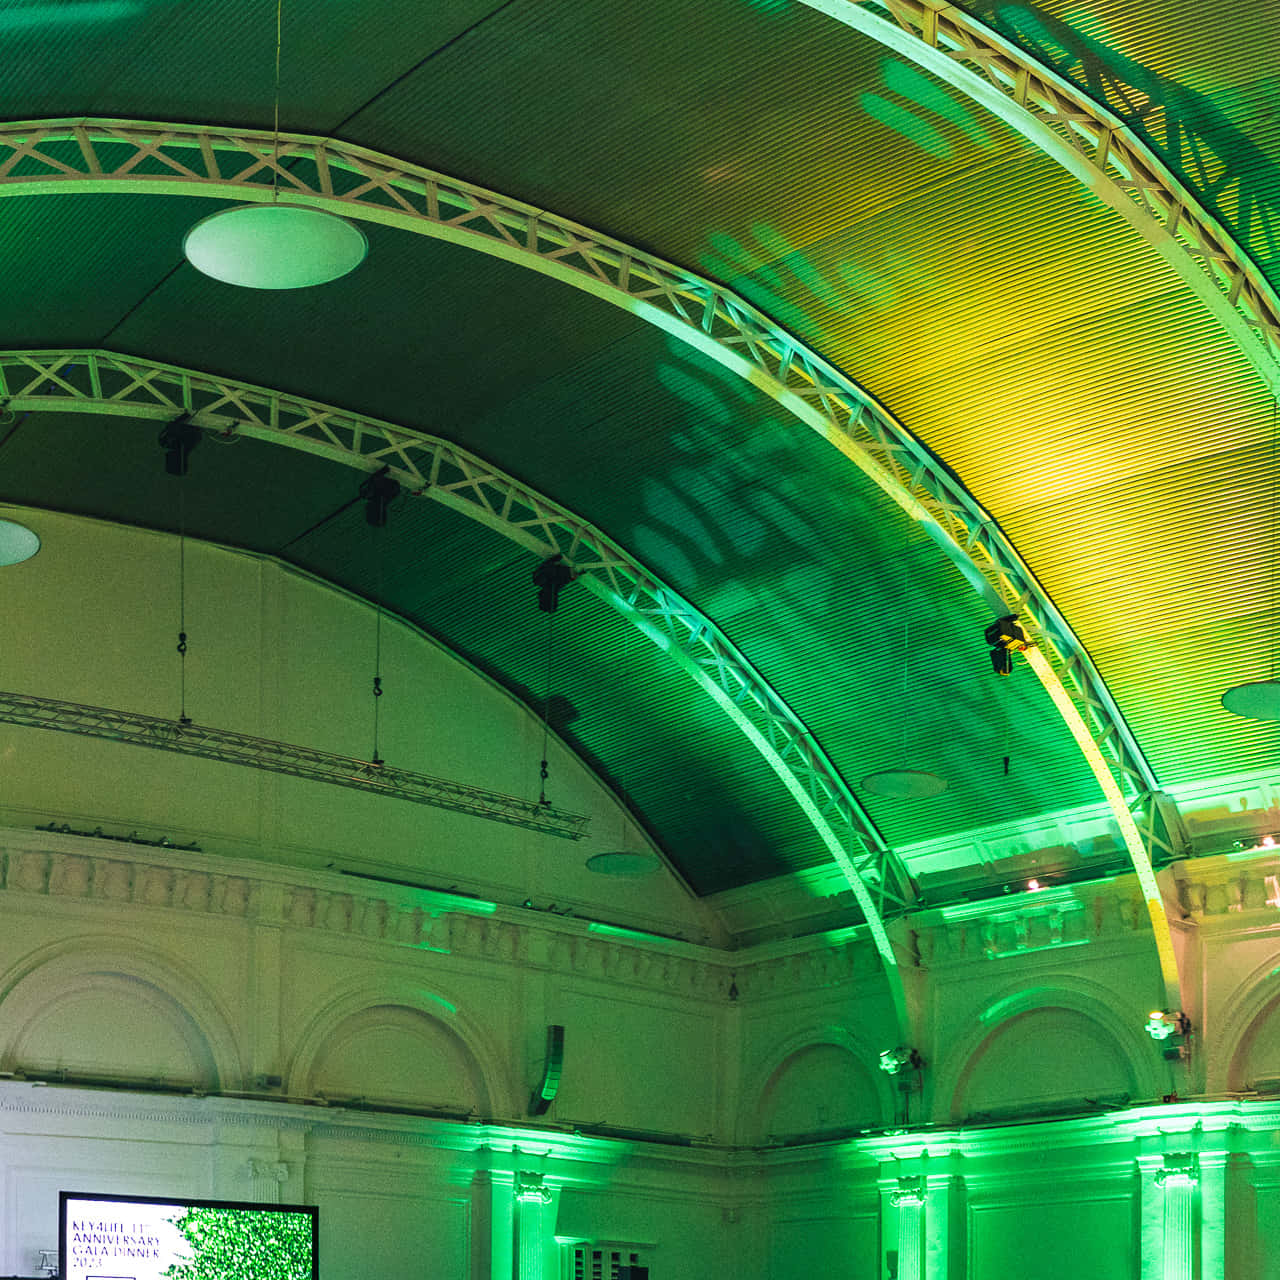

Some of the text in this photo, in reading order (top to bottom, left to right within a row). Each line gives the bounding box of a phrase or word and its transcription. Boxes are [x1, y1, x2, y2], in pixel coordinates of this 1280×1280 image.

[72, 1232, 160, 1246] ANNIVERSARY
[72, 1245, 160, 1259] GALA DINNER
